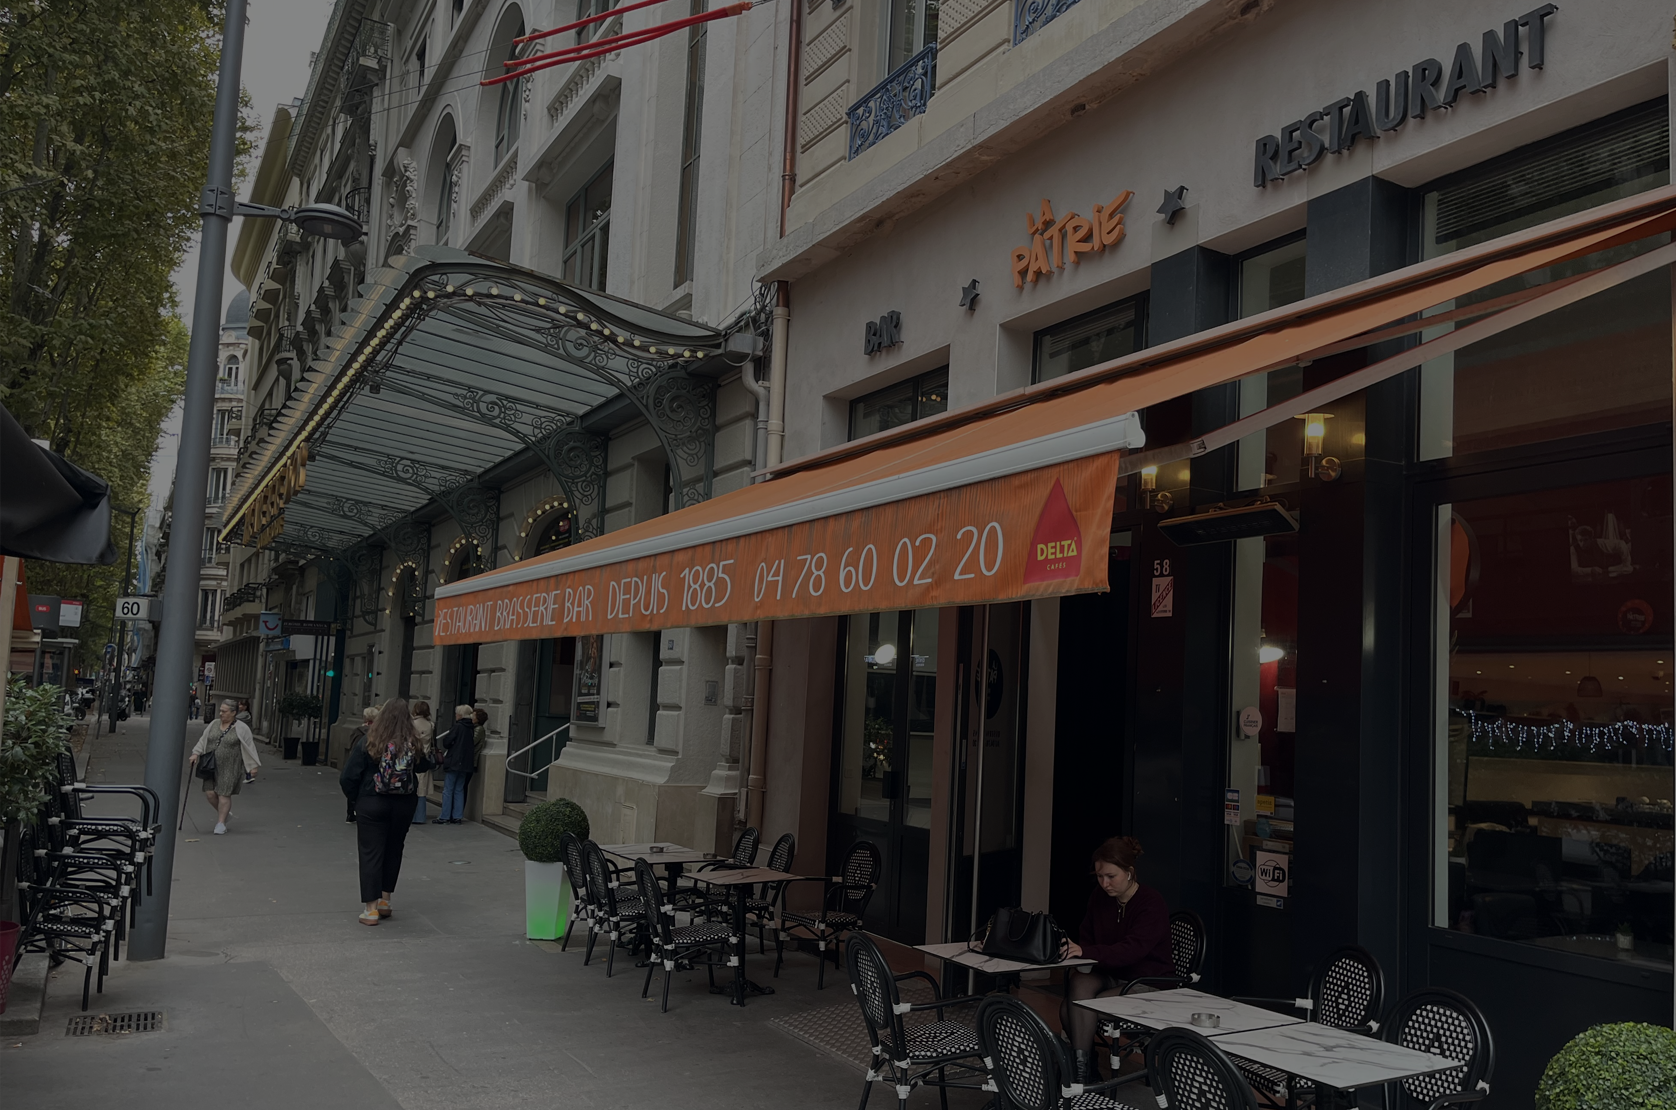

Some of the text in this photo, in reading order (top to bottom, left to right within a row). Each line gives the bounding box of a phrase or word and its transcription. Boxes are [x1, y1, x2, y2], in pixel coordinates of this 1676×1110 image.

[1254, 3, 1556, 188] RESTAURANT
[1026, 198, 1054, 235] LA
[864, 310, 902, 356] BAR
[1037, 539, 1078, 561] DELTA
[494, 590, 561, 631] BRASSERIE
[563, 585, 594, 623] BAR
[607, 571, 669, 619] DEPUIS
[680, 559, 735, 611] 1885
[754, 558, 785, 602] 04
[791, 552, 828, 599] 78
[839, 543, 878, 593] 60
[892, 533, 937, 587] 02
[953, 521, 1004, 580] 20
[1046, 561, 1067, 571] CAFÉS
[1153, 558, 1171, 576] 58
[121, 601, 141, 616] 60
